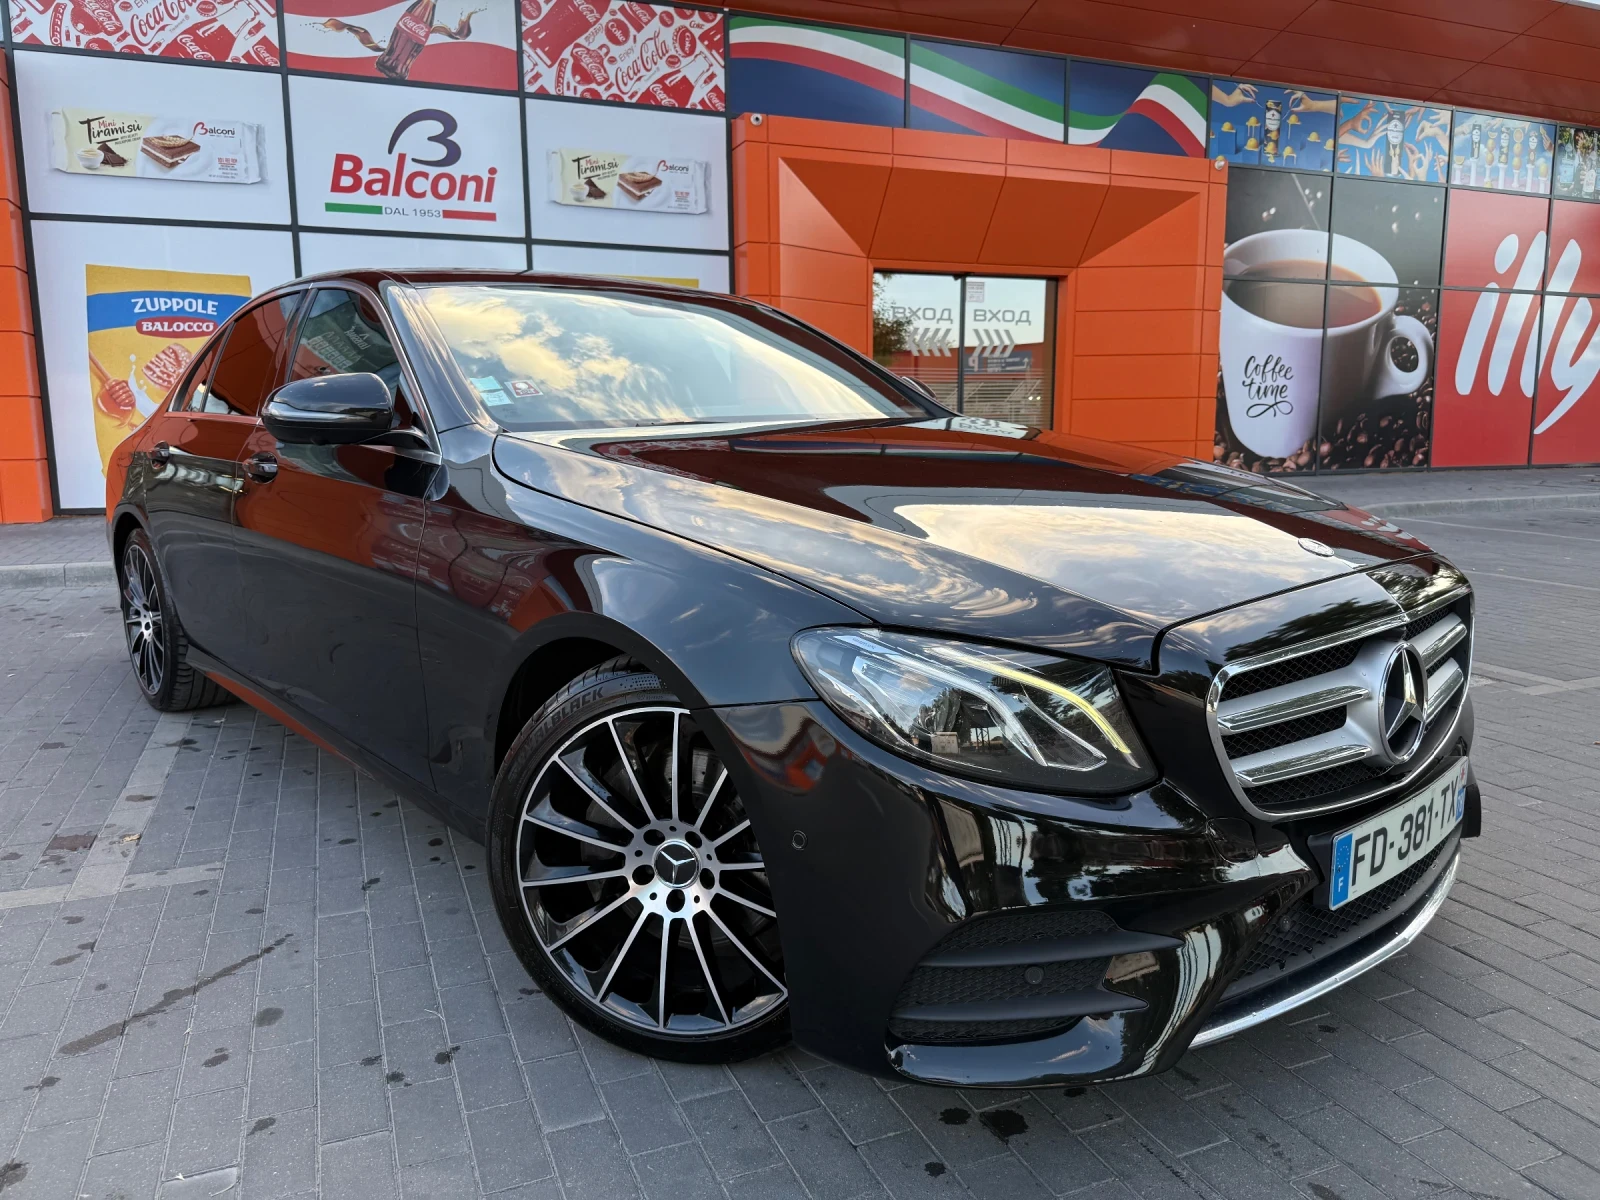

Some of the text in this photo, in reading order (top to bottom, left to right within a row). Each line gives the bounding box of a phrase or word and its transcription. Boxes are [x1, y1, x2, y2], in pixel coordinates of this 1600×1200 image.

[608, 21, 627, 43] Coke
[615, 26, 669, 96] Coca-Cola
[78, 116, 143, 145] Tiramisù
[98, 119, 117, 130] Mini
[192, 121, 236, 137] Balconi
[656, 159, 690, 173] Balconi
[329, 152, 498, 203] Balconi
[384, 206, 442, 219] DAL 1953
[131, 297, 219, 316] ZUPPOLE
[892, 306, 954, 325] ВХОД
[973, 308, 1032, 326] ВХОД
[141, 321, 215, 333] BALOCCO
[1455, 230, 1600, 434] illy
[1244, 354, 1295, 384] Coffee
[1242, 377, 1289, 402] time
[1351, 775, 1460, 888] FD-381-TX
[1337, 876, 1345, 893] F
